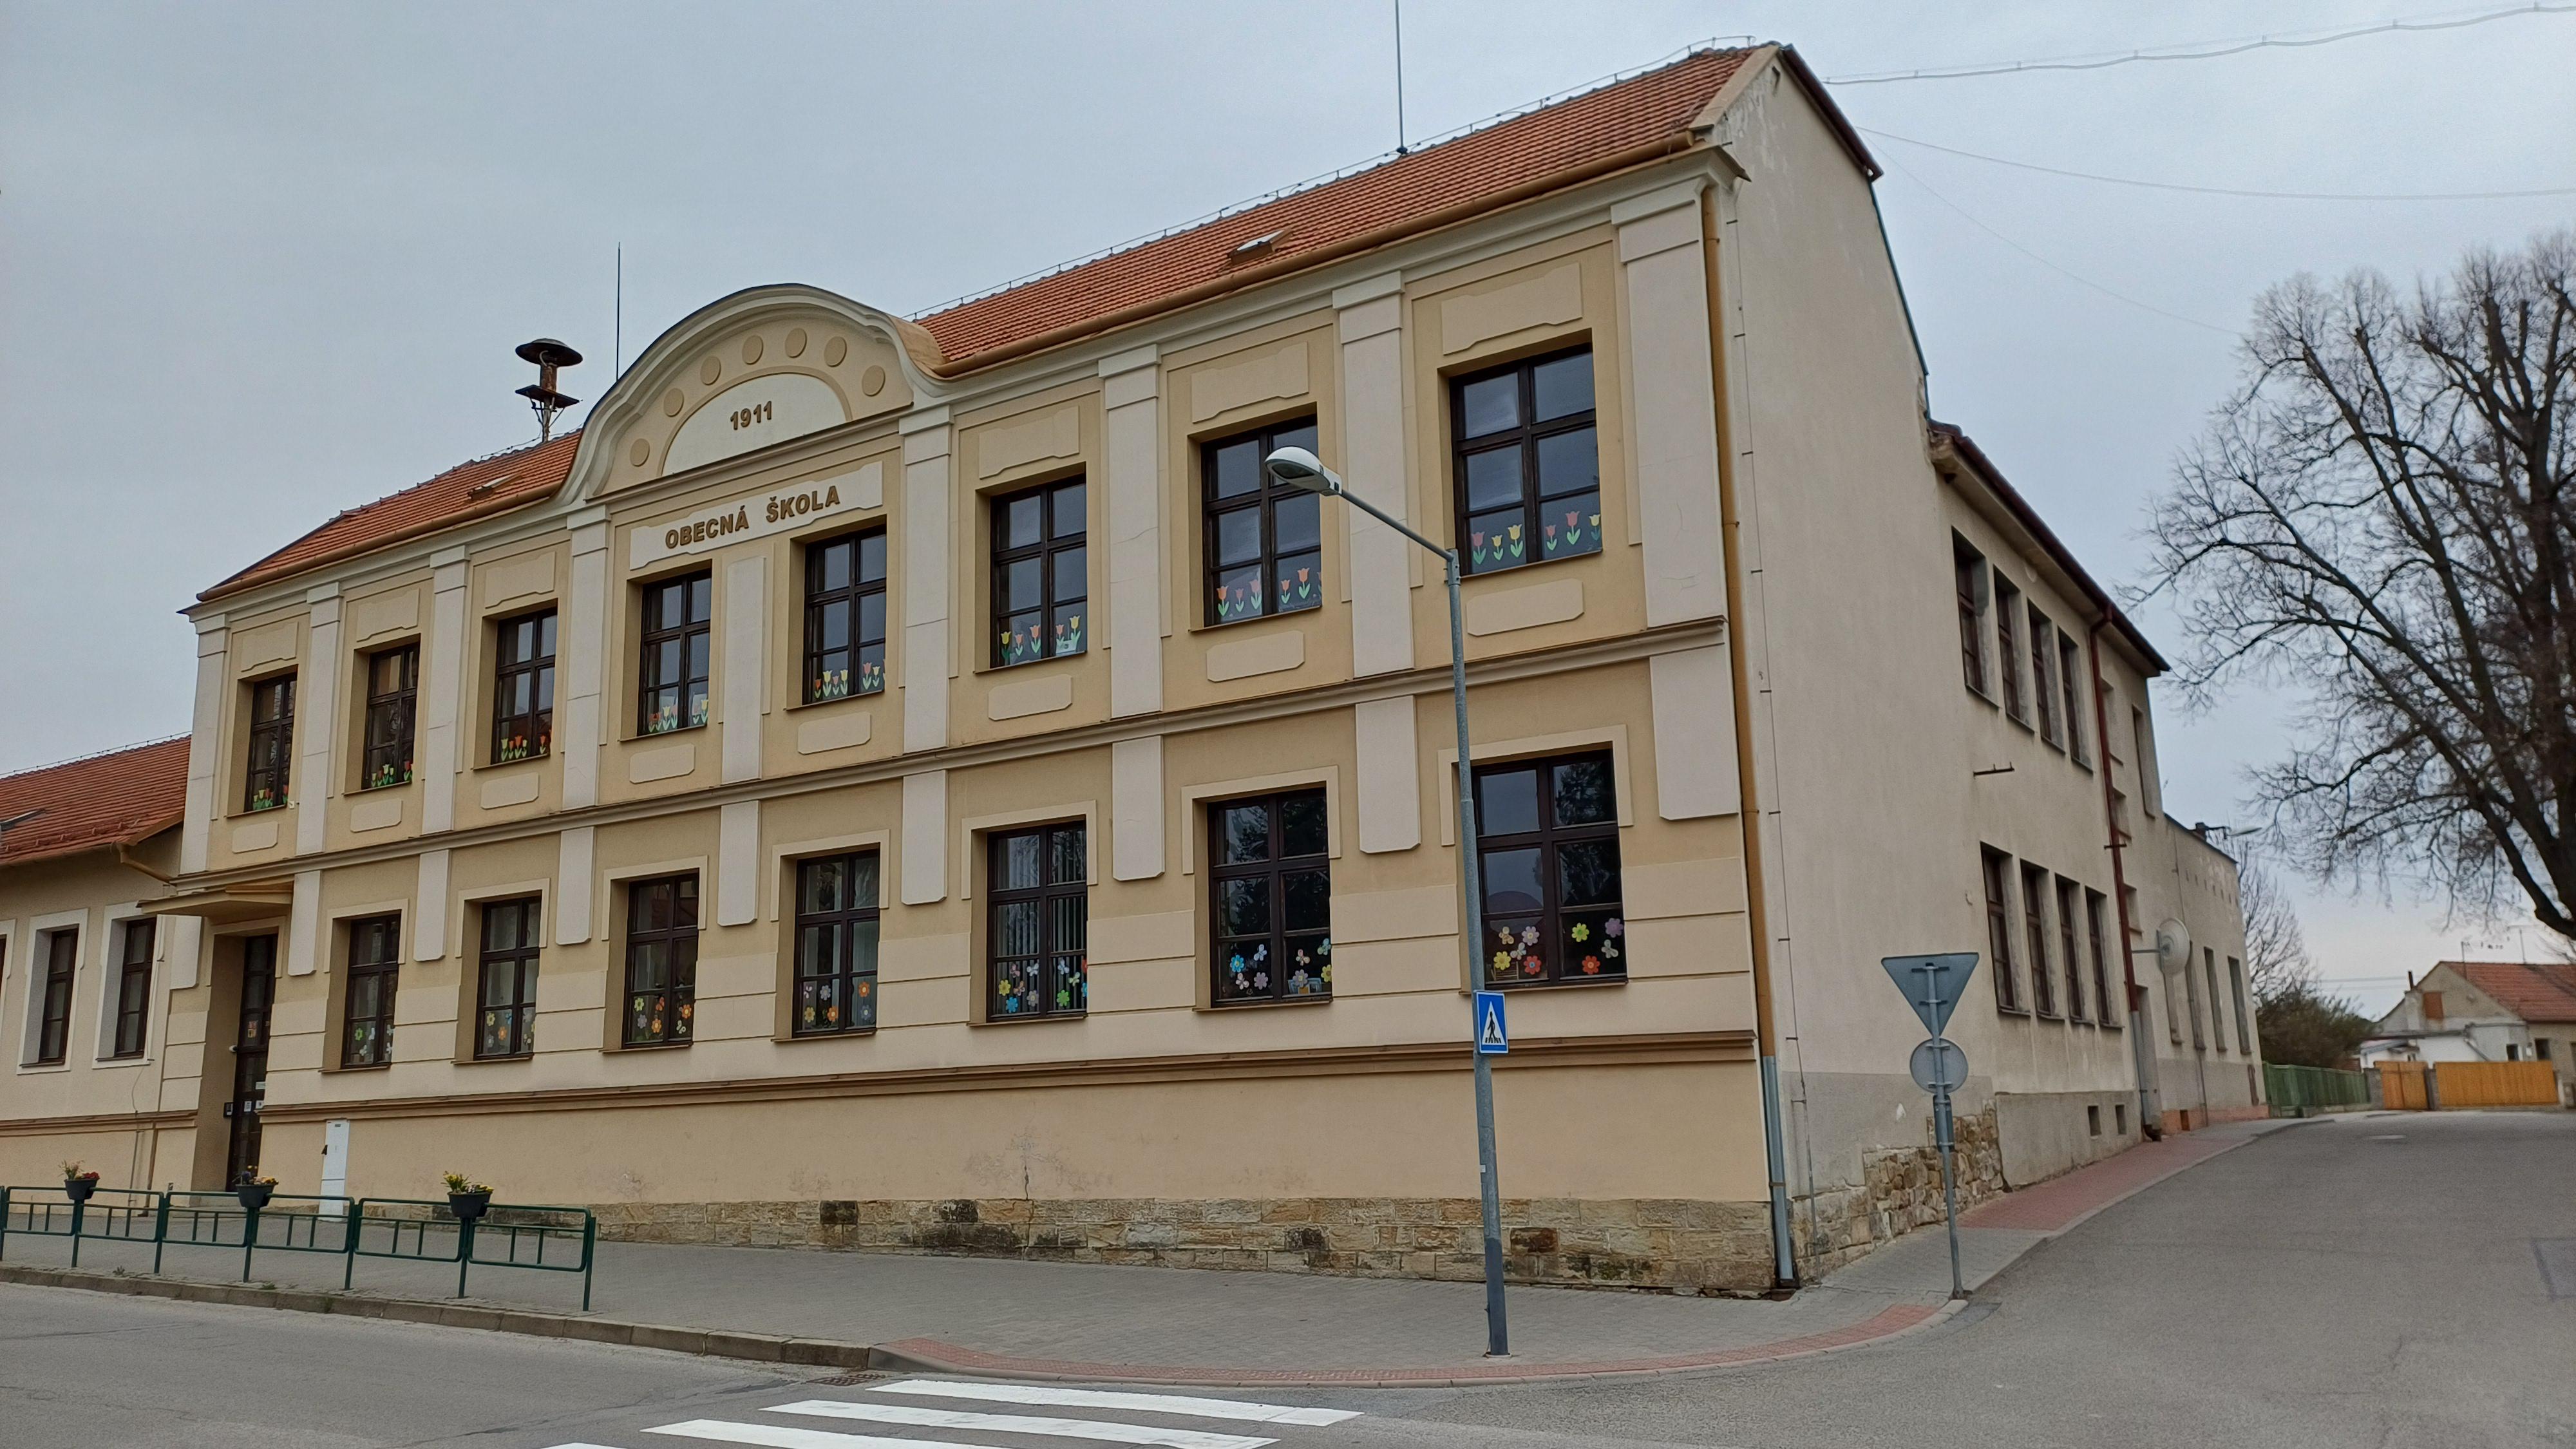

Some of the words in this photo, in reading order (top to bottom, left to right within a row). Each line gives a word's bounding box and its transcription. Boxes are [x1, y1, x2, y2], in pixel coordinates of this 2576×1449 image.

[730, 401, 772, 430] 1911
[666, 505, 749, 549] OBECNÁ
[766, 485, 840, 523] ŠKOLA
